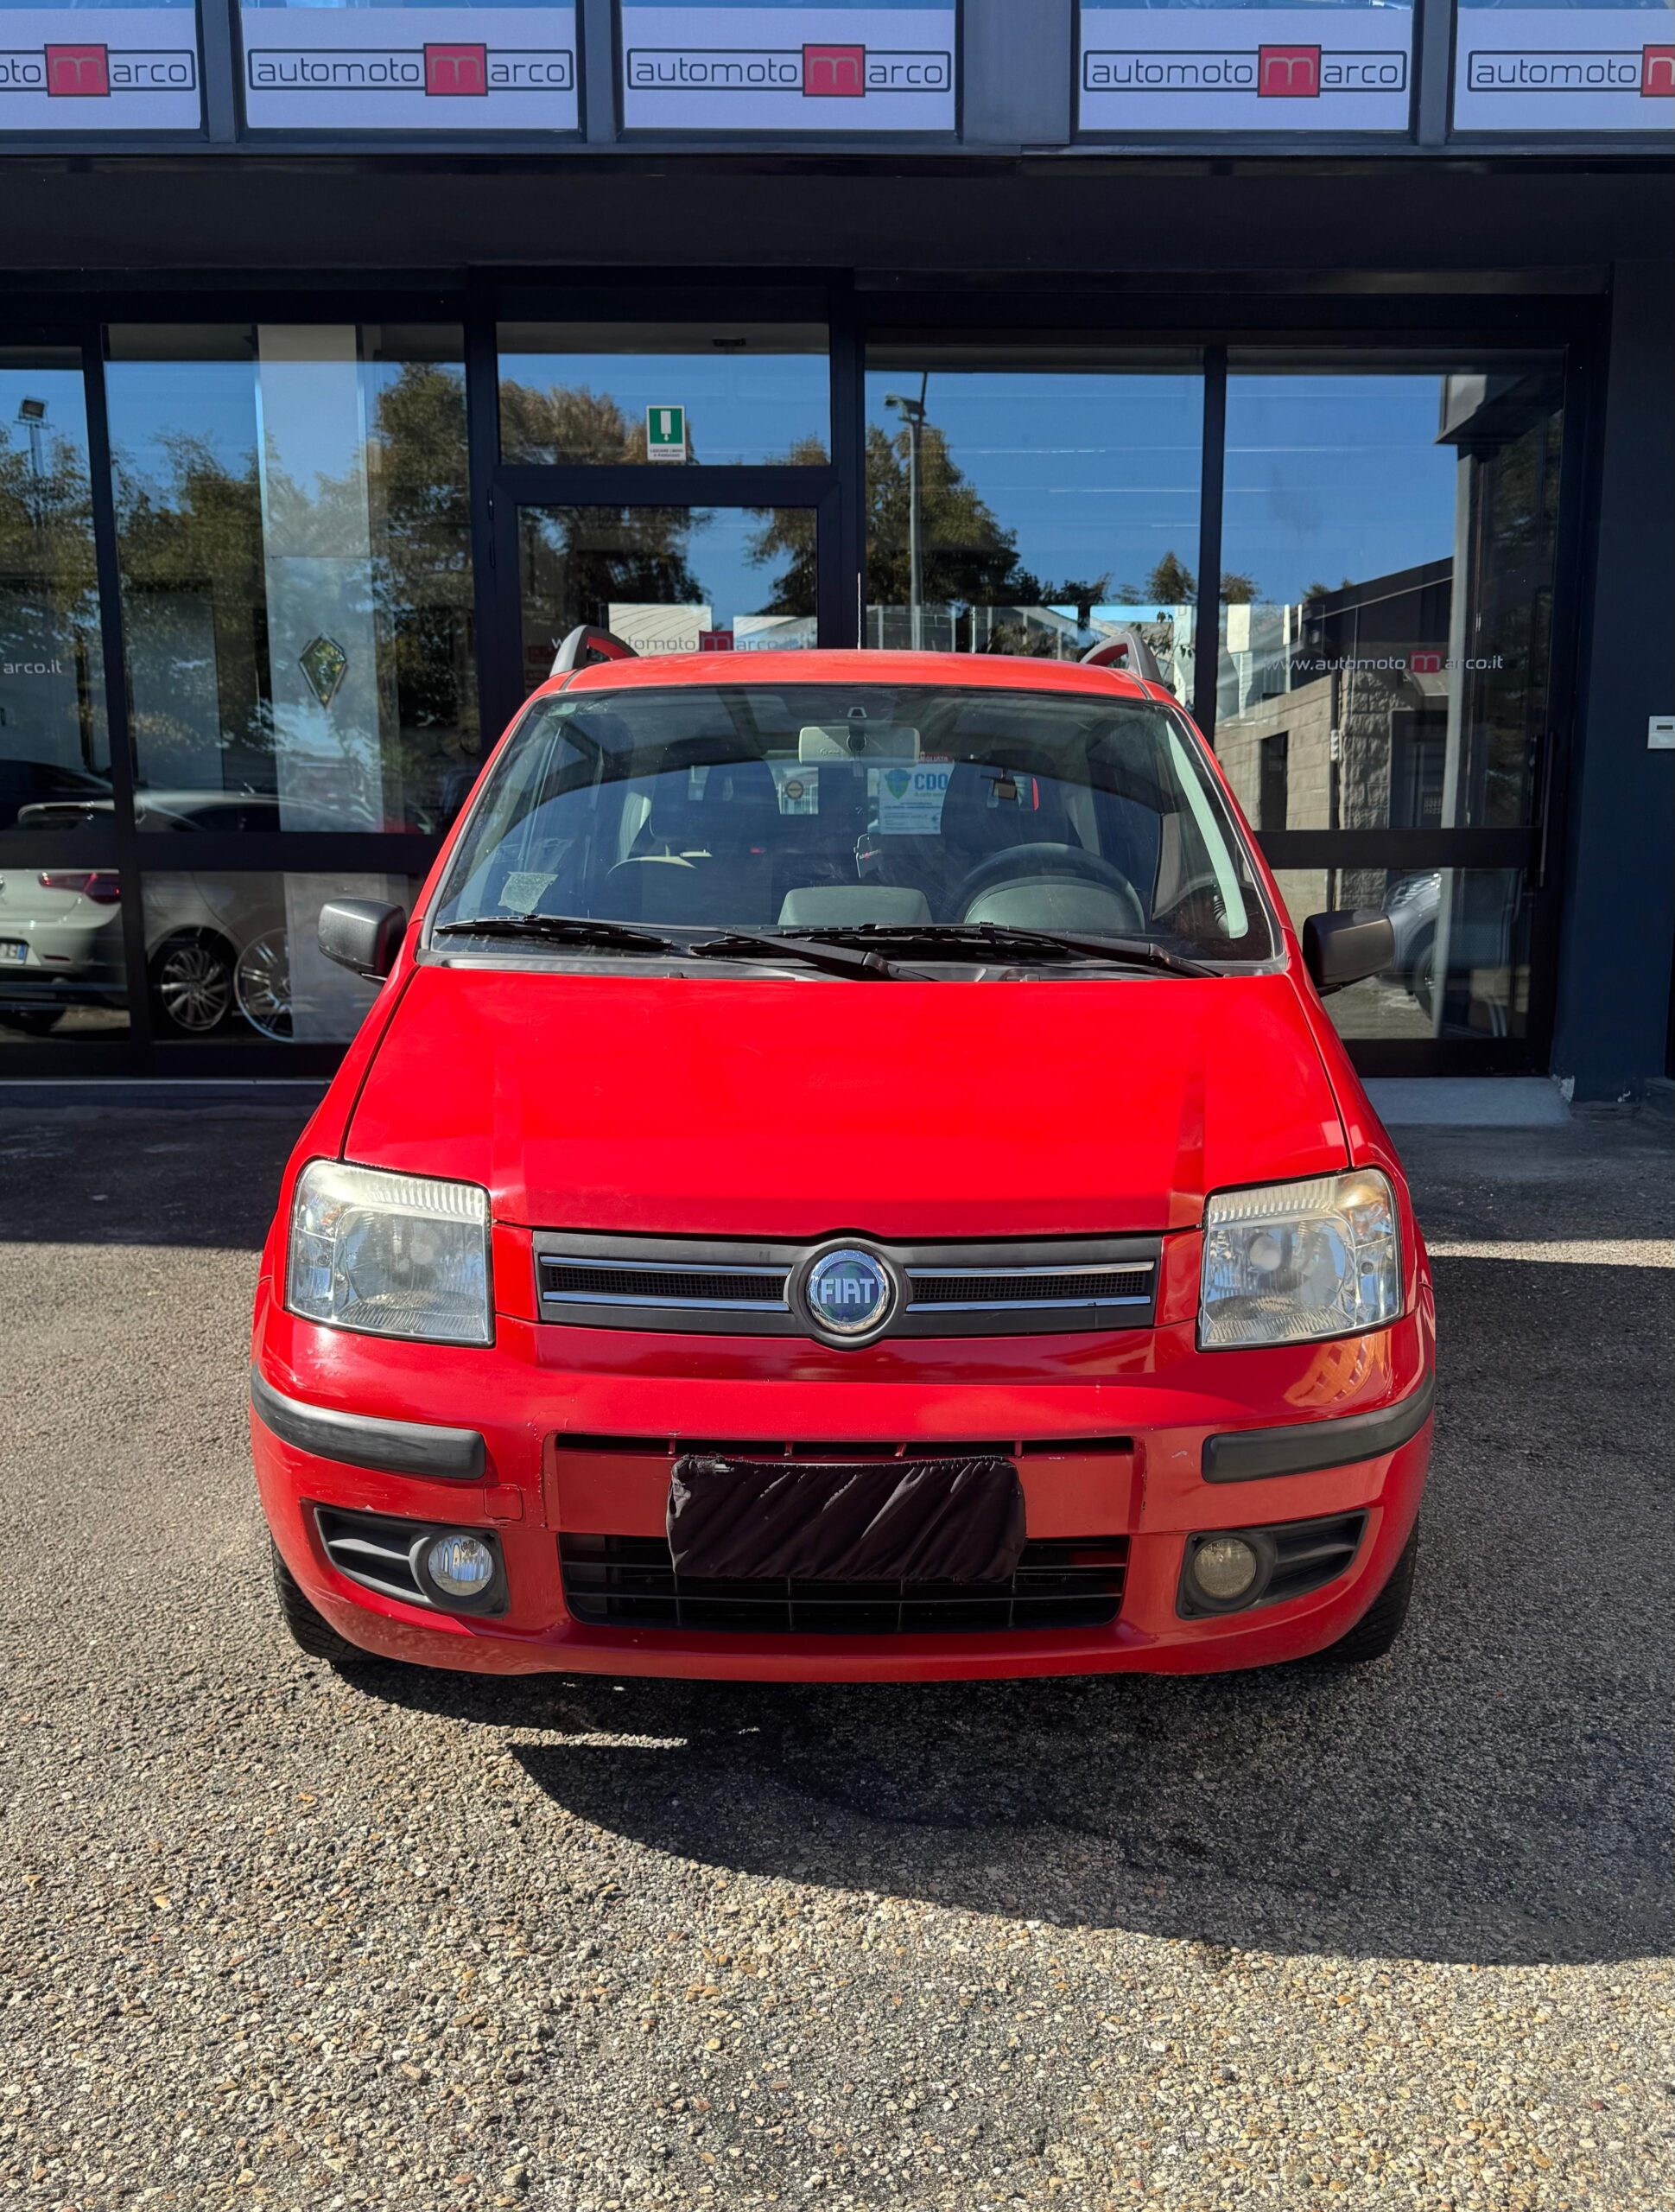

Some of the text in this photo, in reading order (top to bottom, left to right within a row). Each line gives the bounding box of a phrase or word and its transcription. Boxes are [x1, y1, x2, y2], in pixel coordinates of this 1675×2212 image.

[257, 57, 421, 83] automoto
[636, 57, 797, 83] automoto
[1092, 57, 1253, 84] automoto
[1475, 58, 1637, 84] automoto
[821, 1278, 875, 1304] FIAT
